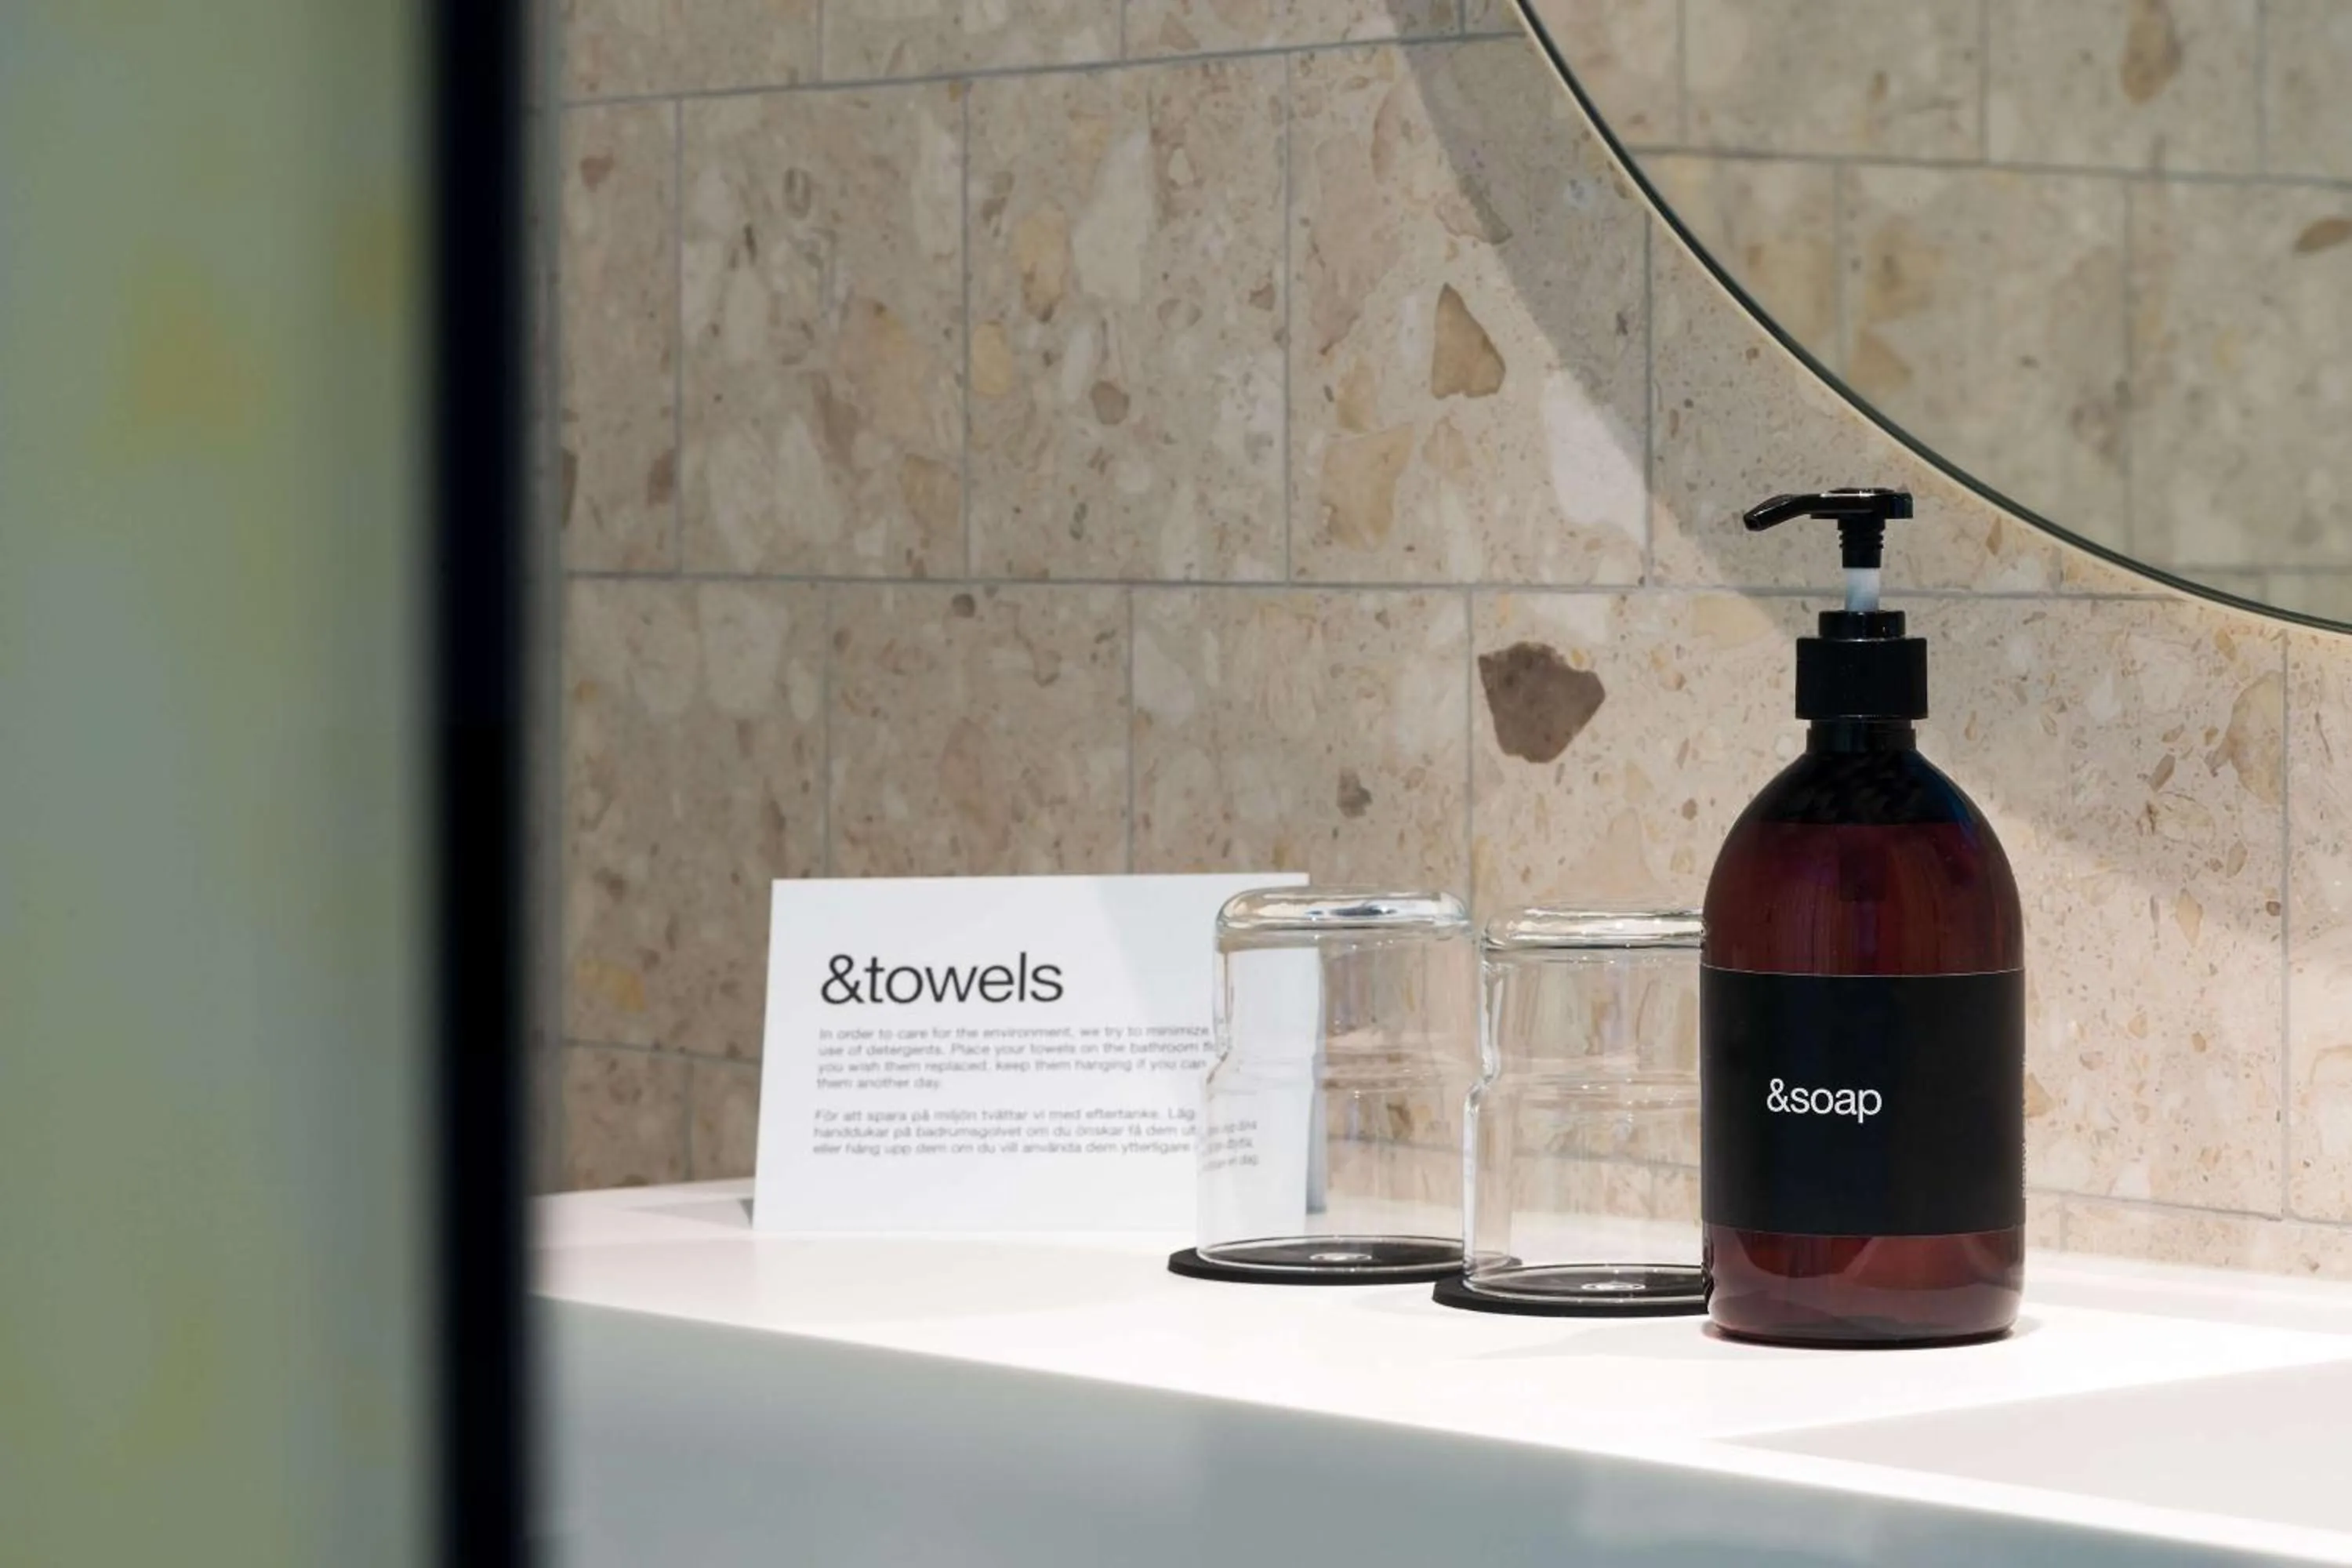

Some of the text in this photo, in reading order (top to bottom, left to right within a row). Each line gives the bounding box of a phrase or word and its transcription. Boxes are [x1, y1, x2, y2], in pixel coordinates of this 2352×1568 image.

[821, 951, 1064, 1004] &towels
[837, 1029, 874, 1040] order
[878, 1028, 893, 1039] to
[898, 1029, 928, 1039] care
[932, 1027, 951, 1038] for
[956, 1026, 978, 1038] the
[1105, 1025, 1122, 1039] try
[1127, 1025, 1142, 1036] to
[1145, 1025, 1209, 1036] minimize
[818, 1046, 844, 1056] use
[848, 1044, 862, 1056] of
[950, 1043, 990, 1054] Place
[994, 1044, 1025, 1056] your
[1030, 1043, 1076, 1054] towels
[1080, 1044, 1099, 1054] on
[1103, 1043, 1125, 1054] the
[1130, 1041, 1199, 1054] bathroom
[818, 1062, 844, 1074] you
[848, 1059, 880, 1072] wish
[884, 1060, 921, 1072] them
[996, 1060, 1030, 1073] keep
[1035, 1059, 1071, 1071] them
[1075, 1058, 1132, 1073] hanging
[1136, 1058, 1145, 1070] if
[1150, 1060, 1177, 1072] you
[1179, 1060, 1207, 1069] can
[817, 1077, 853, 1089] them
[856, 1077, 909, 1089] another
[1766, 1078, 1882, 1123] &soap
[815, 1109, 839, 1121] För
[843, 1110, 862, 1121] att
[867, 1111, 907, 1123] spara
[911, 1109, 931, 1122] på
[933, 1109, 978, 1123] miljön
[982, 1109, 1028, 1121] tvättar
[1033, 1109, 1045, 1120] vi
[1049, 1109, 1080, 1120] med
[1168, 1107, 1195, 1121] Läg
[814, 1127, 889, 1138] handdukar
[893, 1126, 912, 1139] på
[916, 1125, 1022, 1138] badrumsgolvet
[1025, 1126, 1048, 1136] om
[1054, 1124, 1071, 1136] du
[1075, 1124, 1123, 1136] önskar
[1128, 1123, 1142, 1136] få
[1145, 1124, 1178, 1136] dem
[813, 1143, 842, 1154] eller
[845, 1142, 880, 1156] häng
[884, 1145, 912, 1156] upp
[916, 1144, 946, 1154] dem
[951, 1144, 974, 1154] om
[978, 1143, 996, 1154] du
[1000, 1142, 1018, 1153] vill
[1022, 1142, 1083, 1153] använda
[1085, 1142, 1117, 1152] dem
[1121, 1141, 1191, 1155] ytterligare
